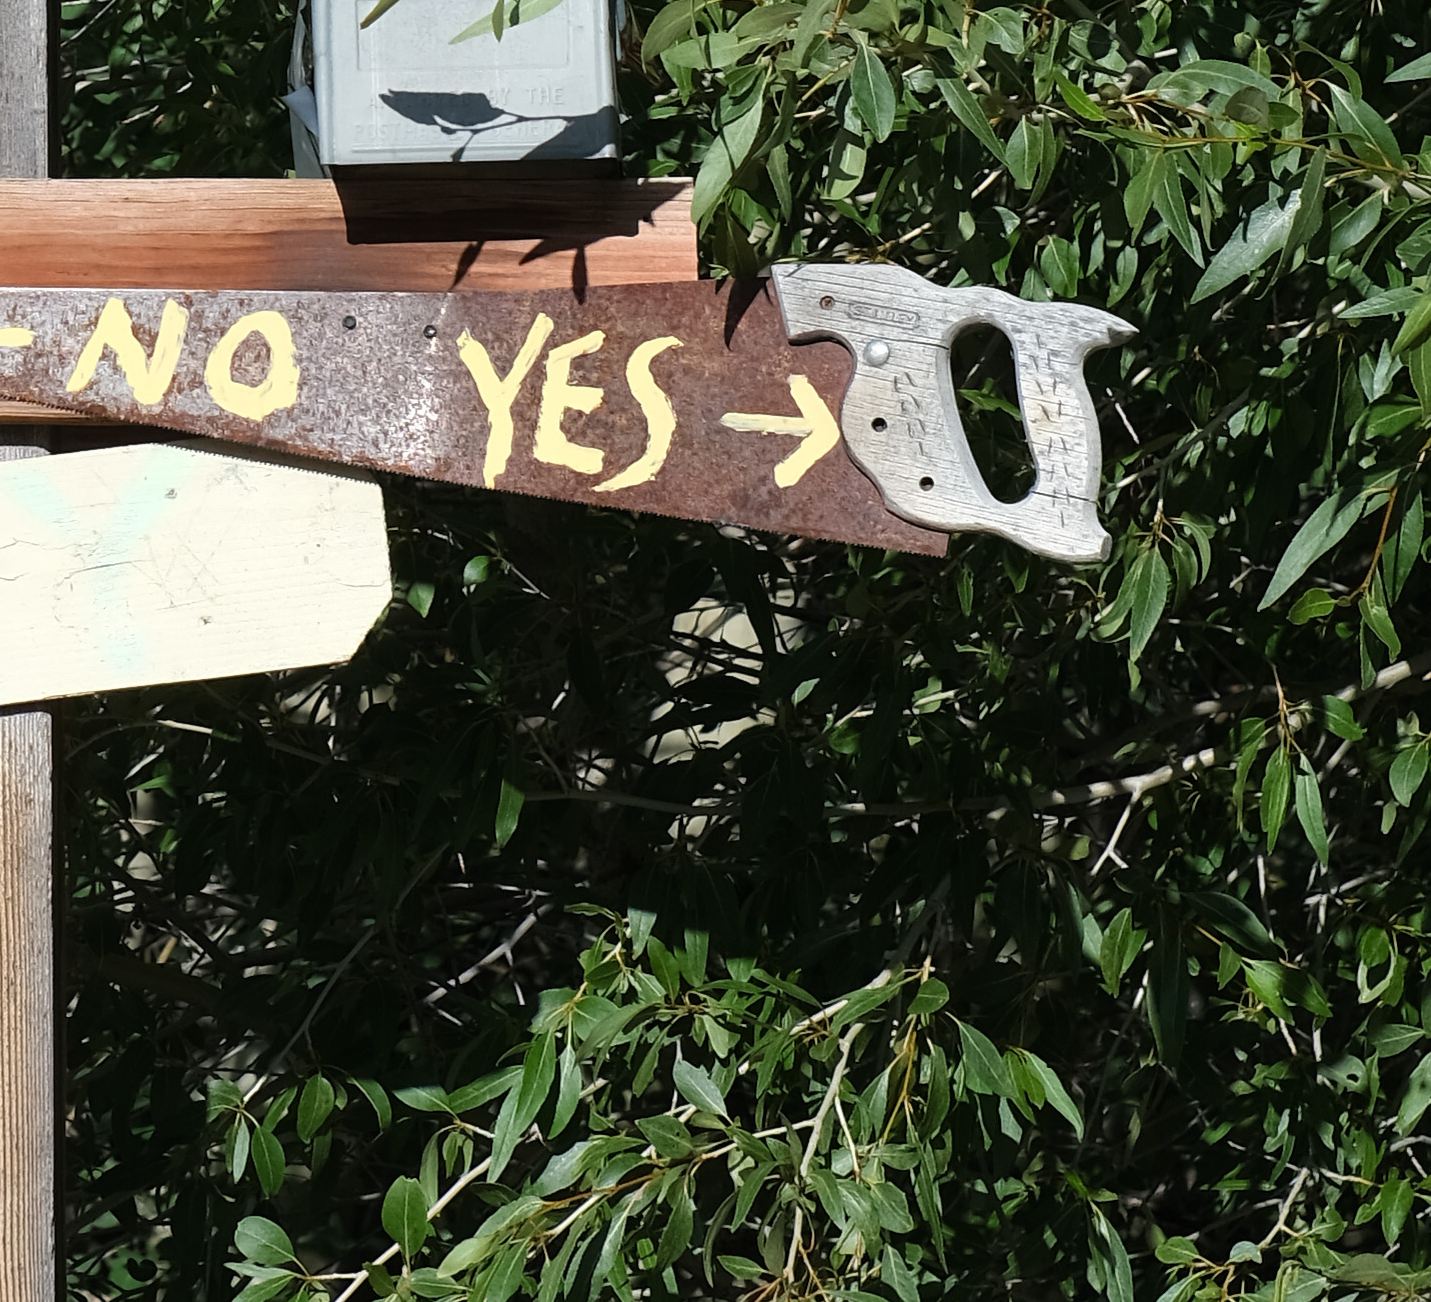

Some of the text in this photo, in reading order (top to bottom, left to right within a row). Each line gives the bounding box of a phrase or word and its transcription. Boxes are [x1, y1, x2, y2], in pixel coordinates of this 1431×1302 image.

[526, 88, 565, 105] THE
[66, 296, 682, 490] NO YES
